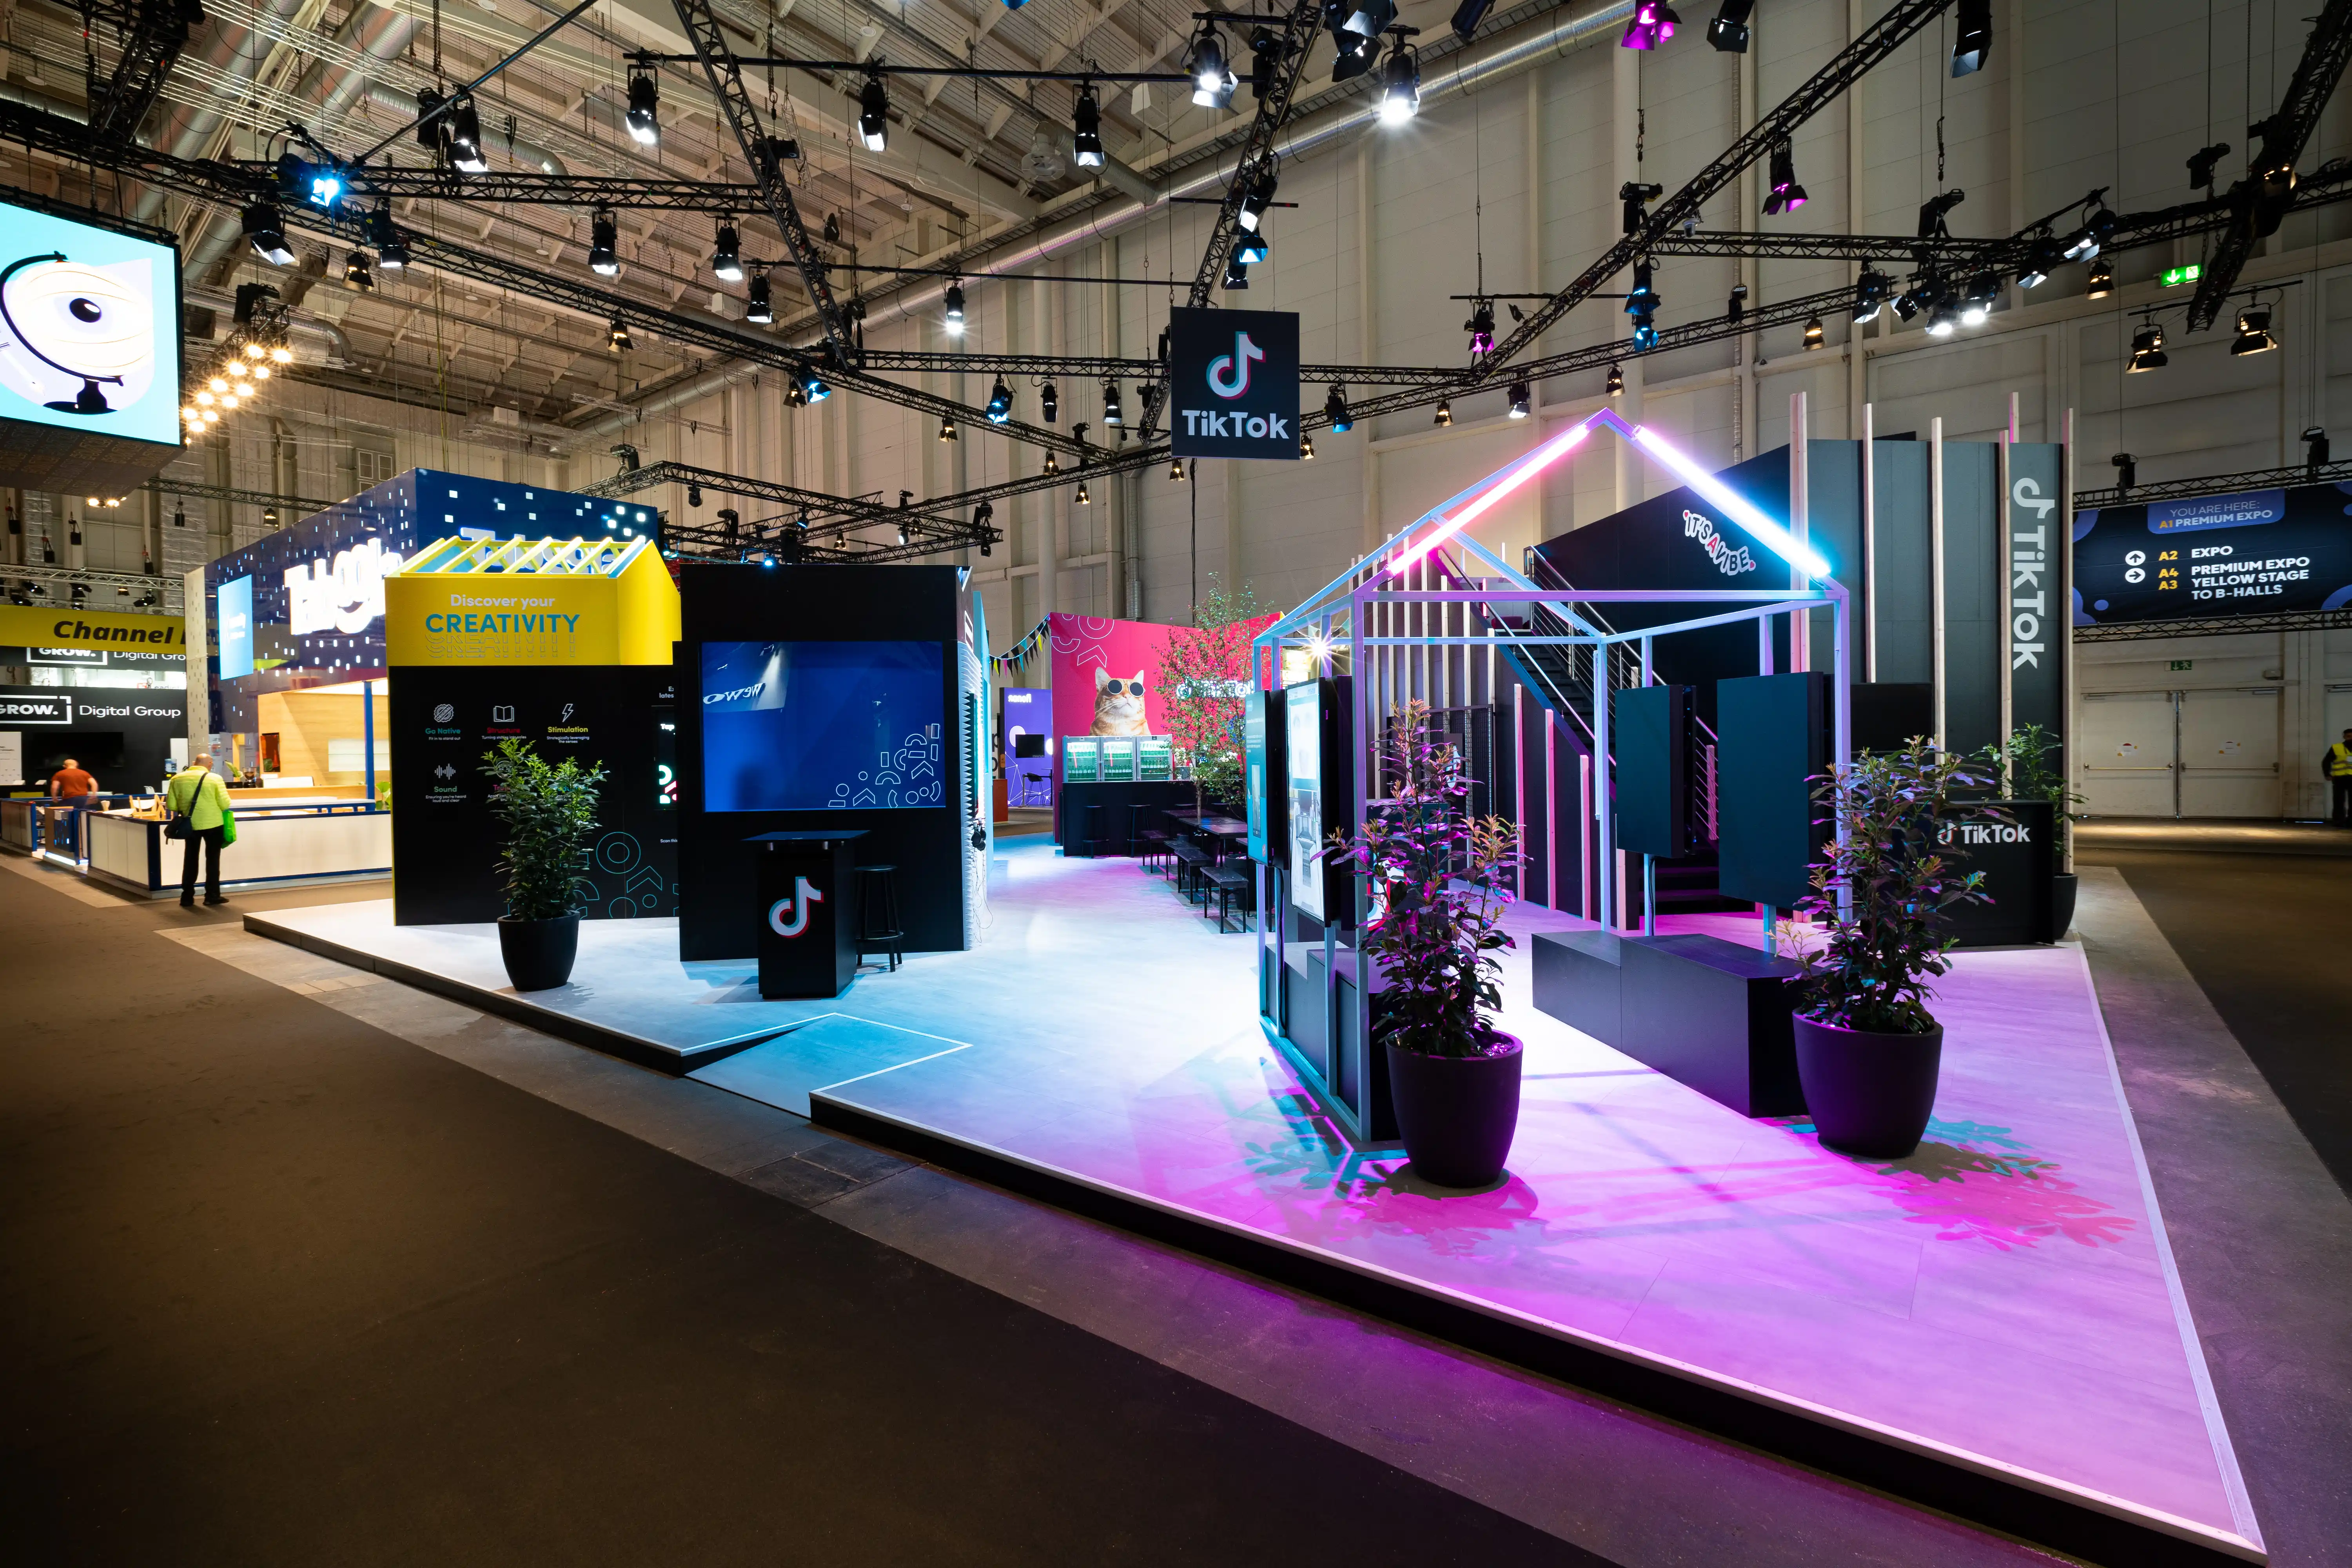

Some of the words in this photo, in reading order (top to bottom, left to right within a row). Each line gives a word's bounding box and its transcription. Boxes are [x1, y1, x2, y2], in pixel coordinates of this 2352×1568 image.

[1182, 410, 1289, 439] TikTok
[2159, 520, 2173, 528] A1
[2175, 514, 2234, 527] PREMIUM
[2236, 509, 2273, 521] EXPO
[2170, 508, 2196, 517] YOU
[2198, 505, 2222, 514] ARE
[2224, 501, 2260, 511] HERE:
[1715, 544, 1749, 572] VIBE
[2159, 550, 2178, 561] A2
[2191, 546, 2233, 558] EXPO
[2159, 568, 2178, 578] A4
[2191, 560, 2262, 576] PREMIUM
[2266, 557, 2310, 570] EXPO
[2159, 580, 2178, 590] A3
[2191, 573, 2256, 588] YELLOW
[2258, 569, 2309, 583] STAGE
[2013, 525, 2045, 671] TikTok
[2192, 590, 2212, 600] TO
[2216, 584, 2283, 599] B-HALLS
[450, 594, 518, 607] Discover
[521, 596, 555, 610] your
[53, 620, 174, 644] Channel
[426, 613, 581, 633] CREATIVITY
[1008, 693, 1032, 703] sanofi
[80, 705, 130, 718] Digital
[134, 706, 181, 719] Group
[437, 706, 452, 720] ORIGINAL
[1961, 824, 2031, 844] TikTok
